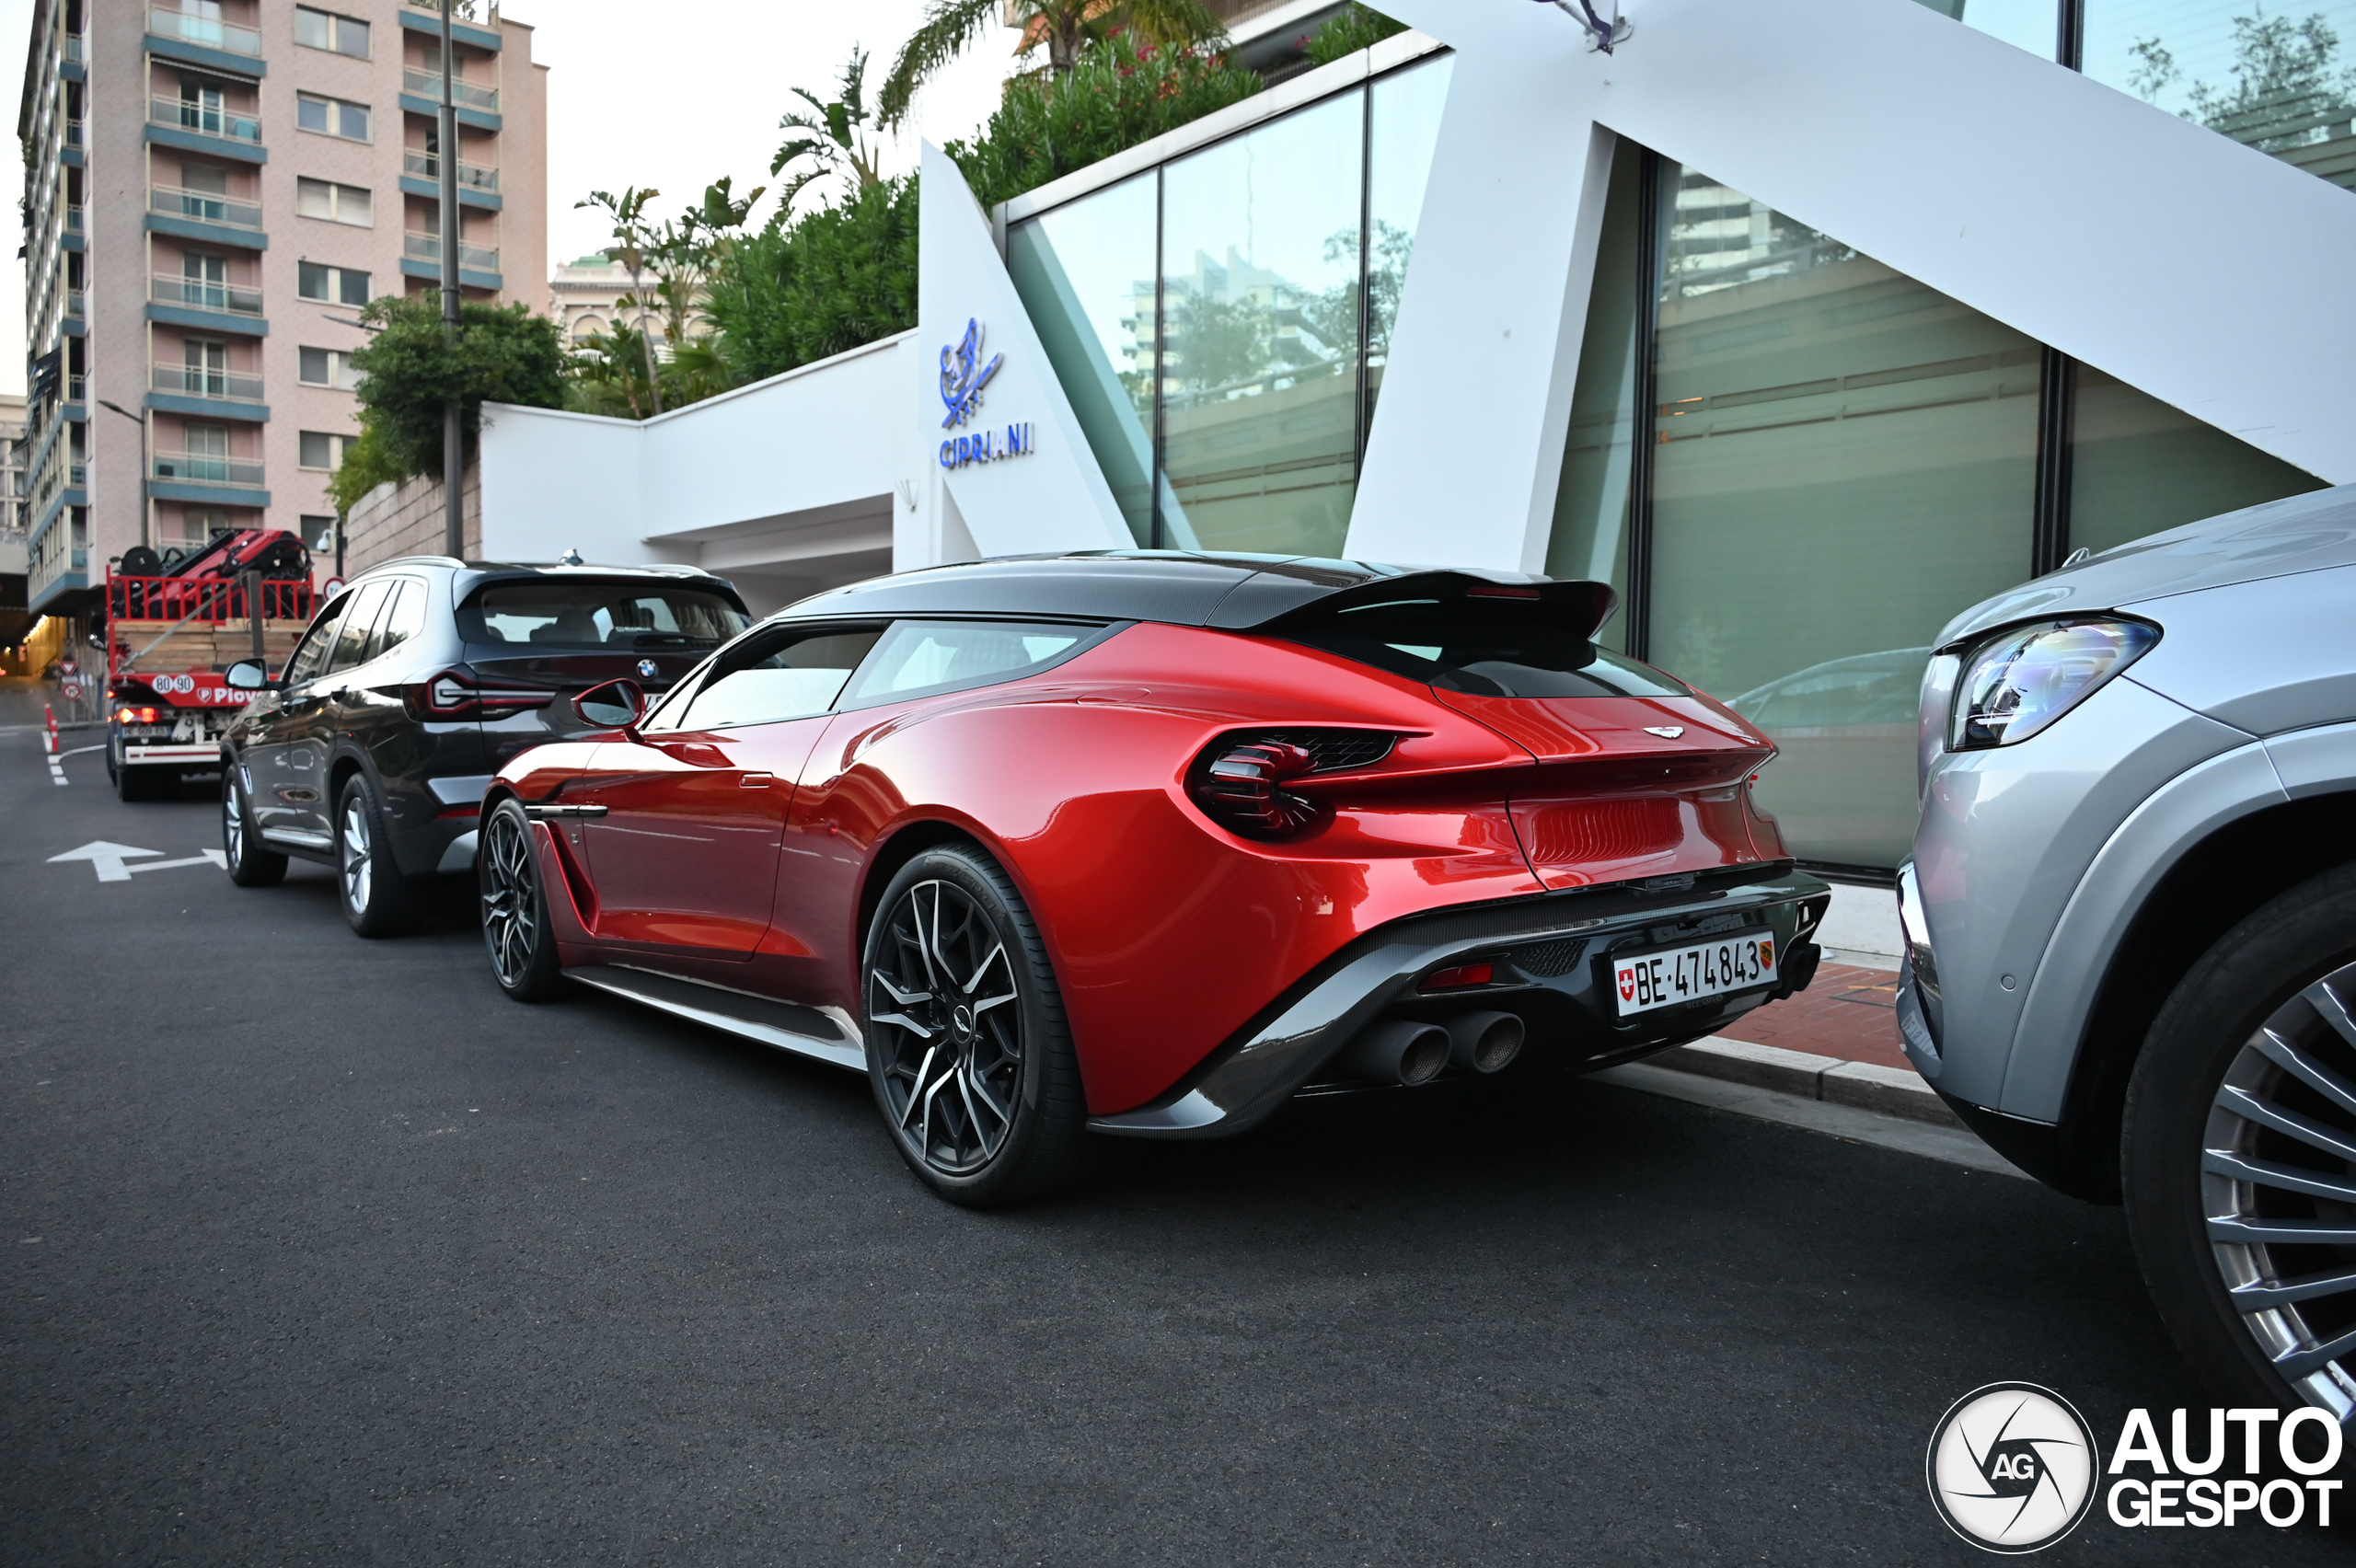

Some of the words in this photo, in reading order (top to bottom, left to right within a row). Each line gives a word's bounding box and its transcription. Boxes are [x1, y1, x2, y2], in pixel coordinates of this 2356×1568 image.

[940, 422, 1033, 468] CIPRIANI
[156, 675, 170, 691] 80
[177, 675, 191, 691] 90
[214, 687, 263, 704] Piov
